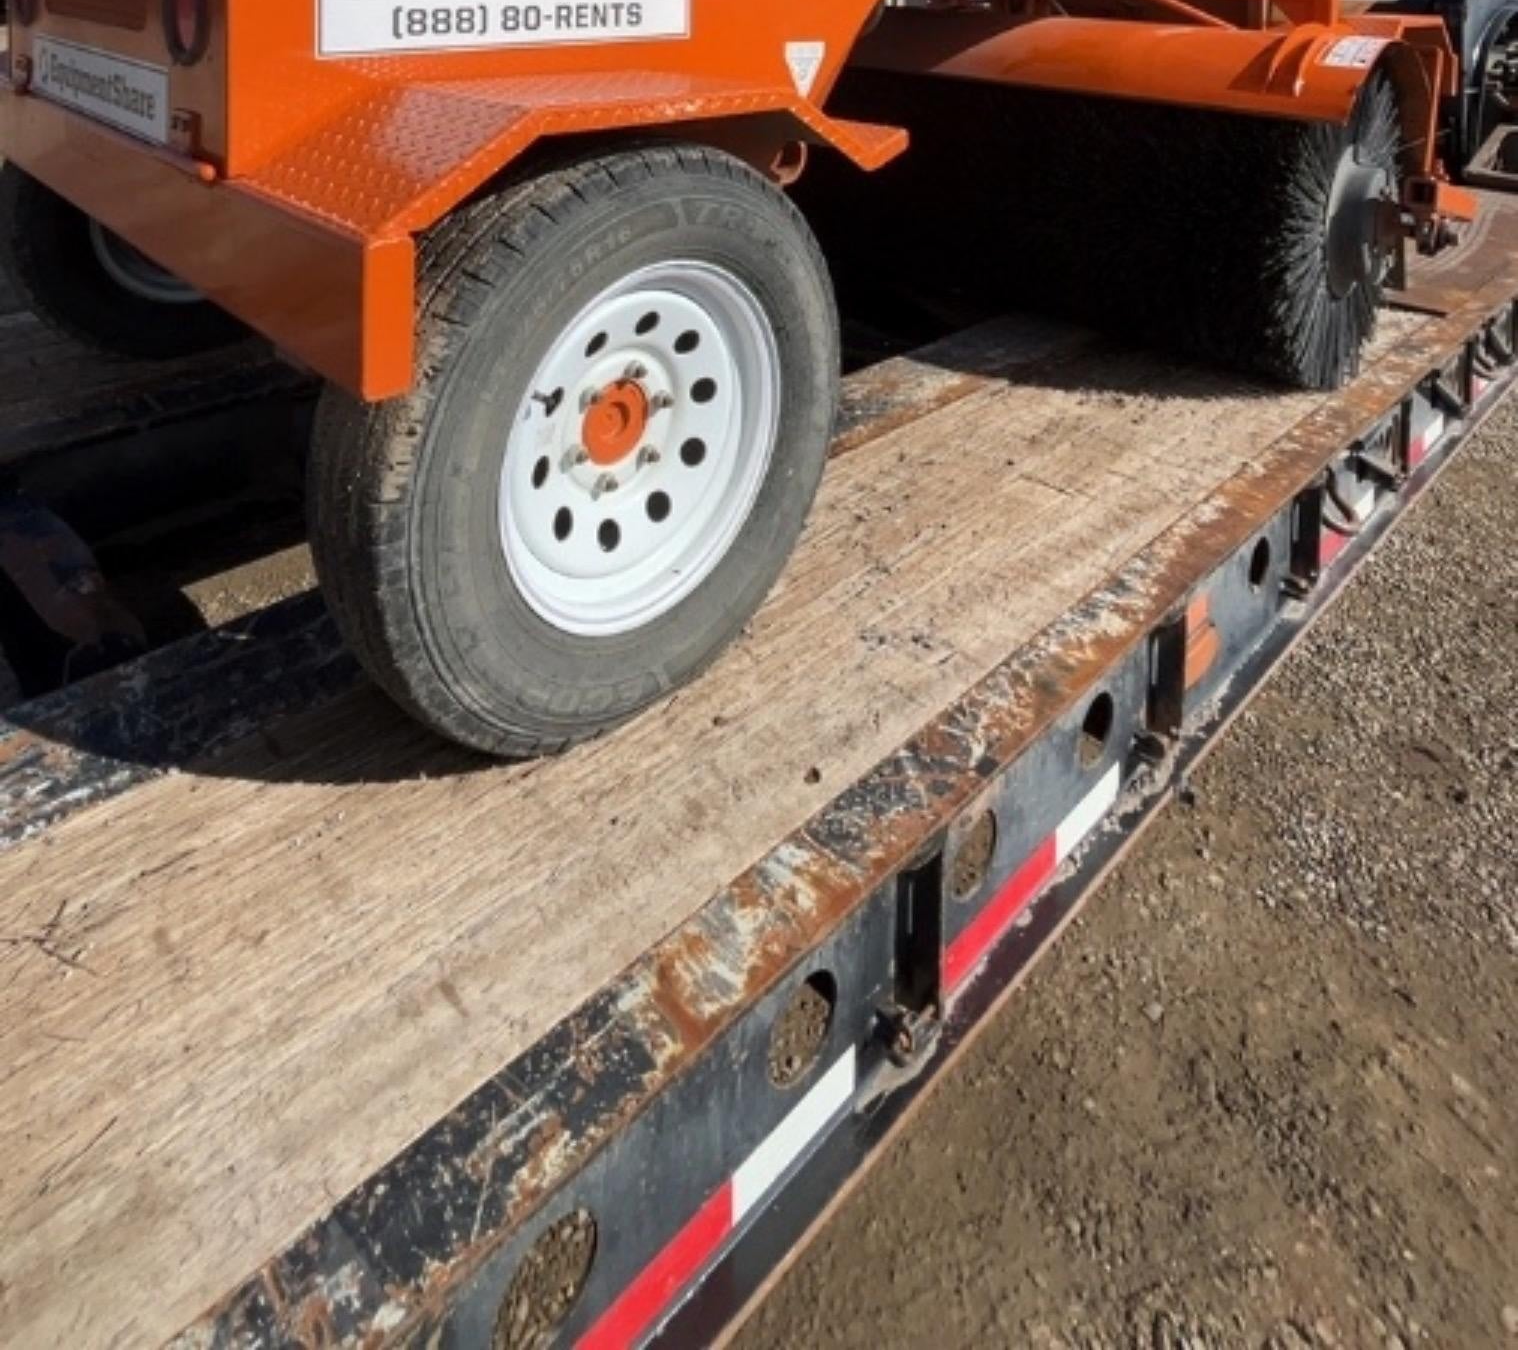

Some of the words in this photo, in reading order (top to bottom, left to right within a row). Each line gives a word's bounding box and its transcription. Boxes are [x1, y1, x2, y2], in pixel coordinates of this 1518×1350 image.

[392, 5, 488, 38] (888)
[500, 2, 643, 31] 80-RENTS
[50, 52, 156, 121] EquipmentShare
